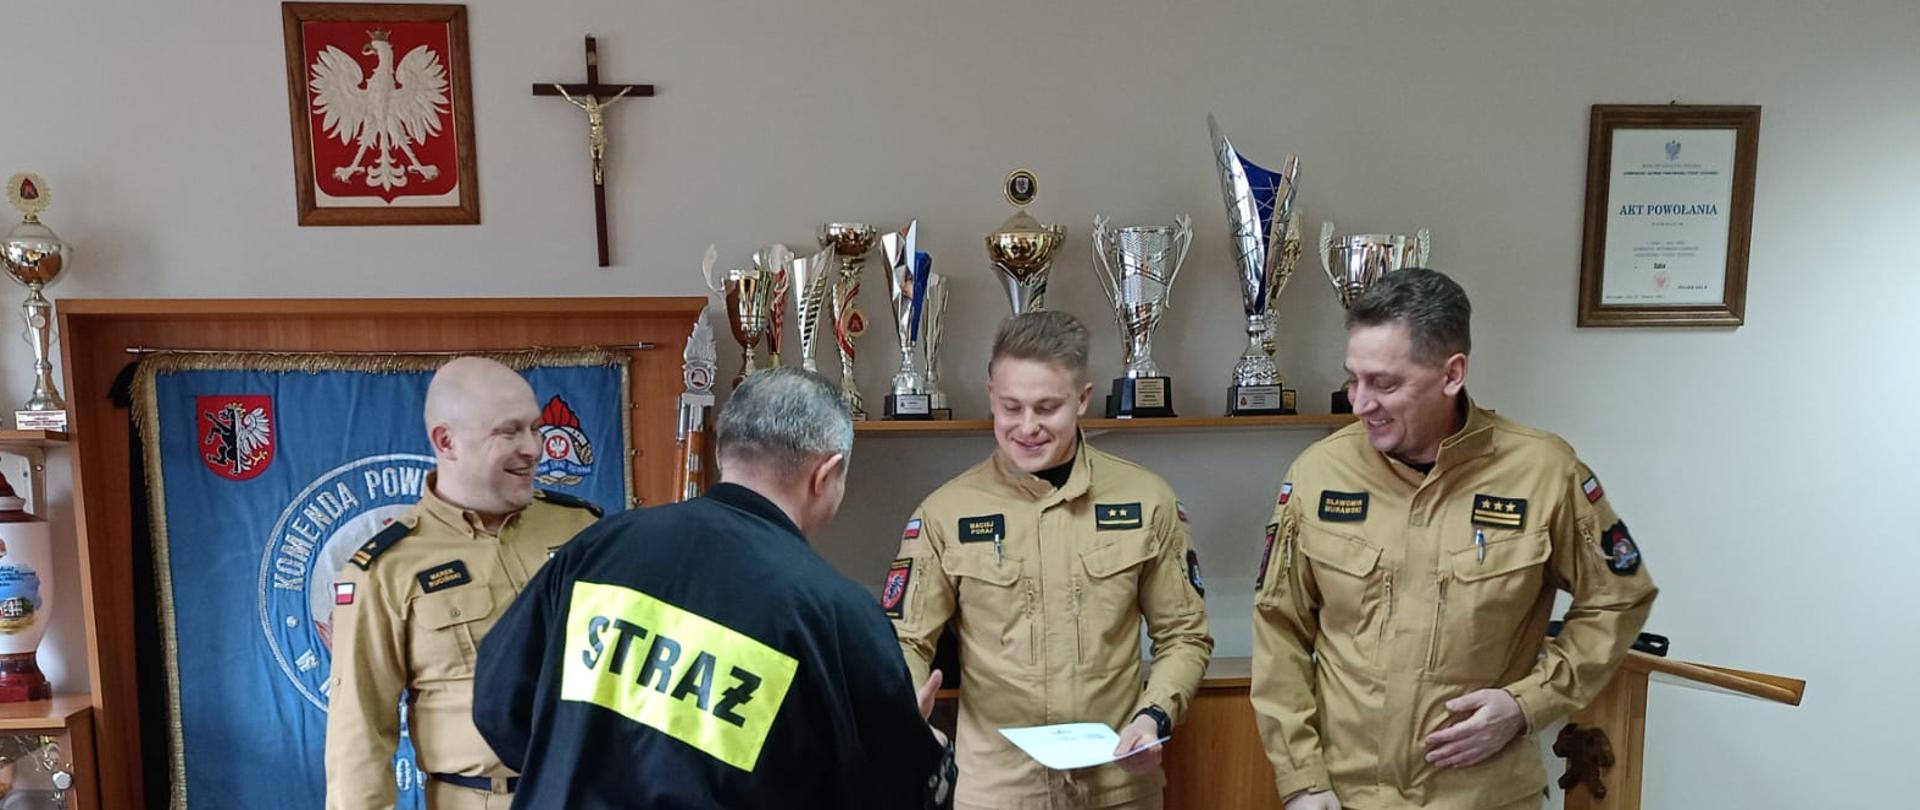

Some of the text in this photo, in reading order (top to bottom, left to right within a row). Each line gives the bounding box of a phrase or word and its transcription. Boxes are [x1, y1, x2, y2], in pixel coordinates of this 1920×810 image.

[1619, 204, 1718, 215] AKT POWOŁANIA
[273, 466, 428, 592] KOMENDA POWI
